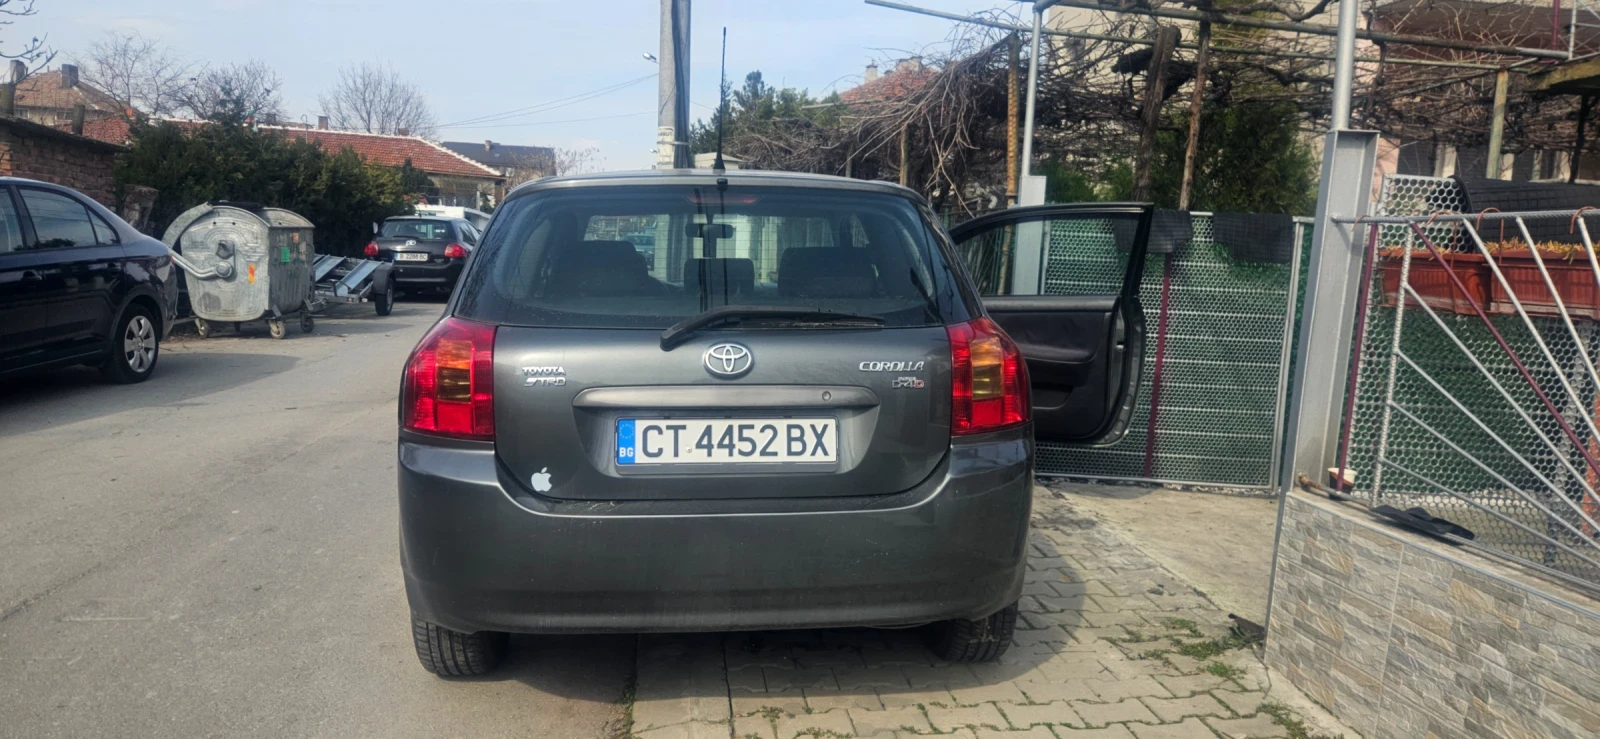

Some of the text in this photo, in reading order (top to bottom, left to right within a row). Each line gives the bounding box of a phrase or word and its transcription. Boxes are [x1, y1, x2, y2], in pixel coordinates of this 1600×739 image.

[522, 366, 566, 376] TOYOTA
[859, 361, 925, 372] COROLLA
[642, 423, 830, 458] CT 4452 BX
[619, 447, 634, 458] BG
